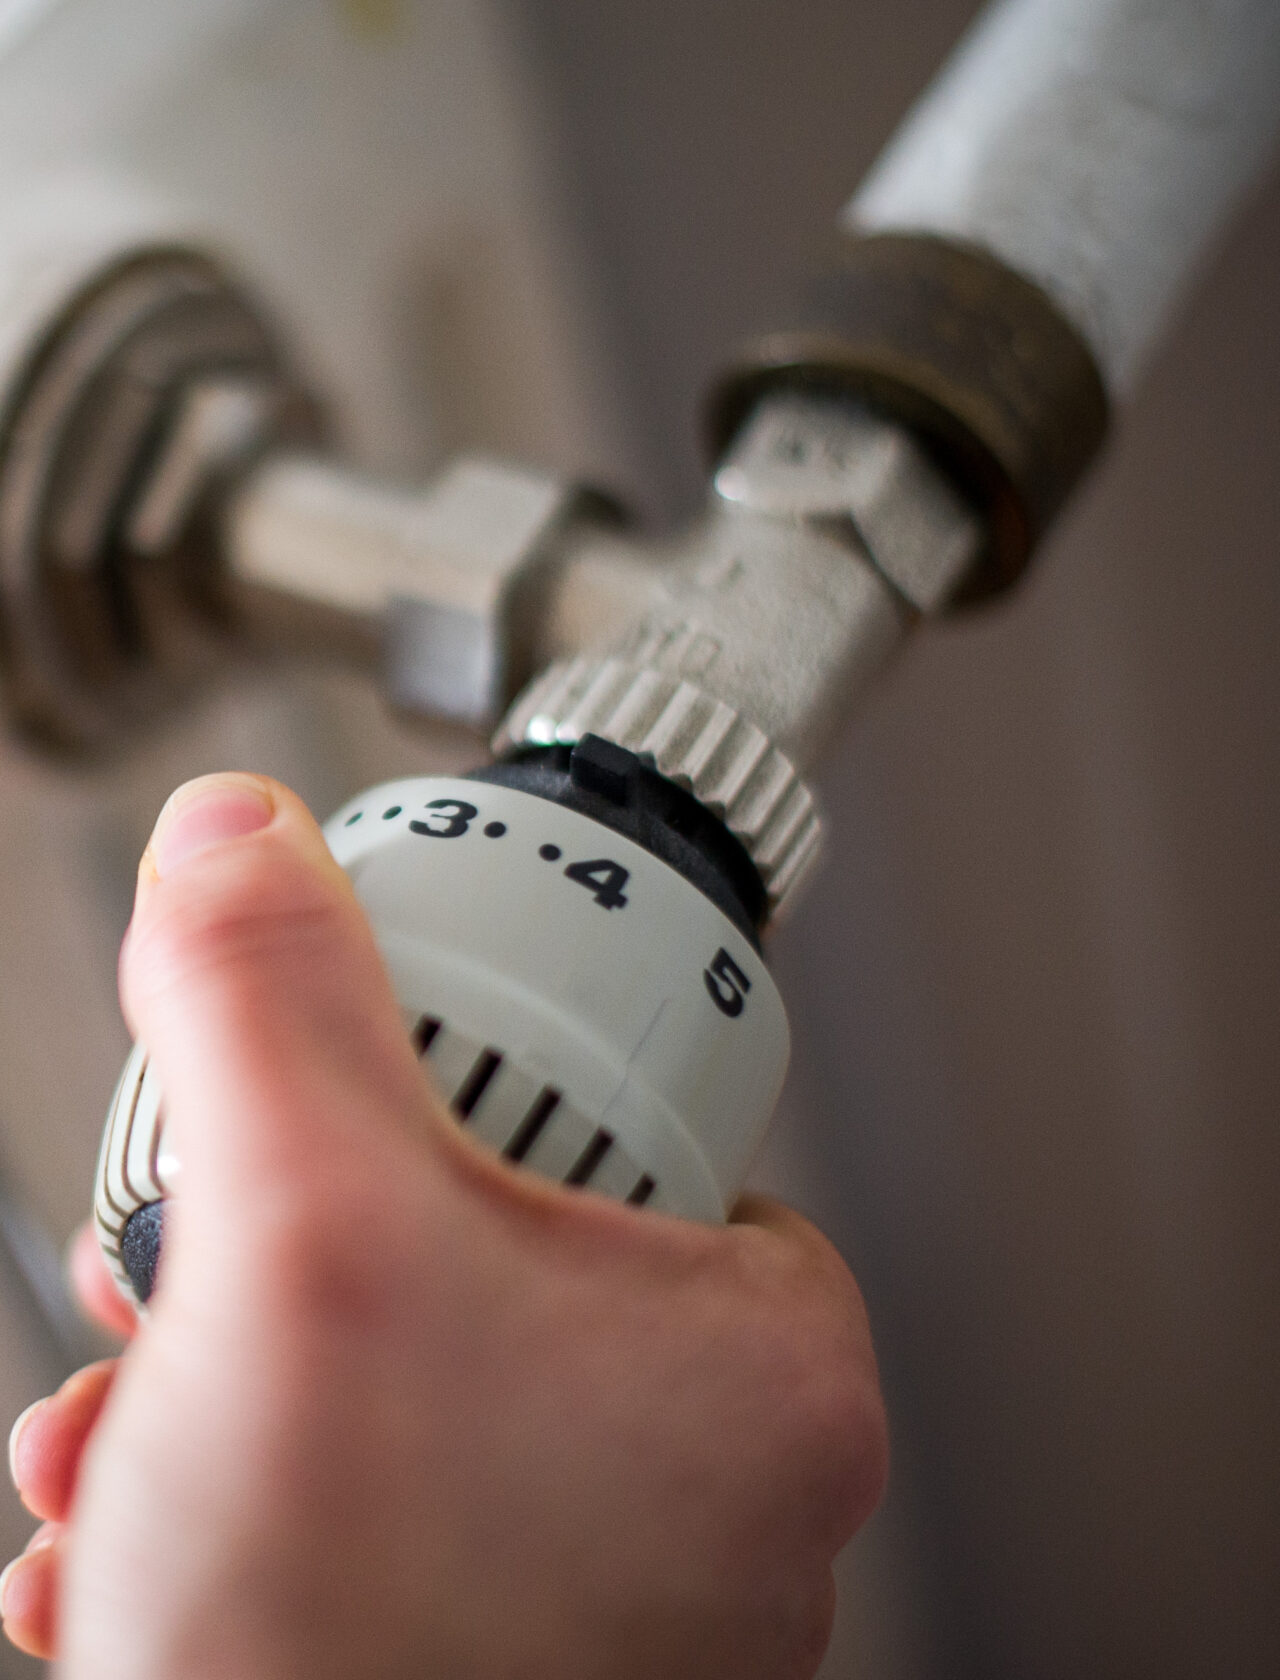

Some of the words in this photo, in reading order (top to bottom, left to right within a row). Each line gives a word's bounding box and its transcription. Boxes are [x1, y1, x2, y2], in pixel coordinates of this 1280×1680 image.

[409, 798, 479, 839] 3
[563, 858, 631, 912] 4
[703, 946, 751, 1019] 5
